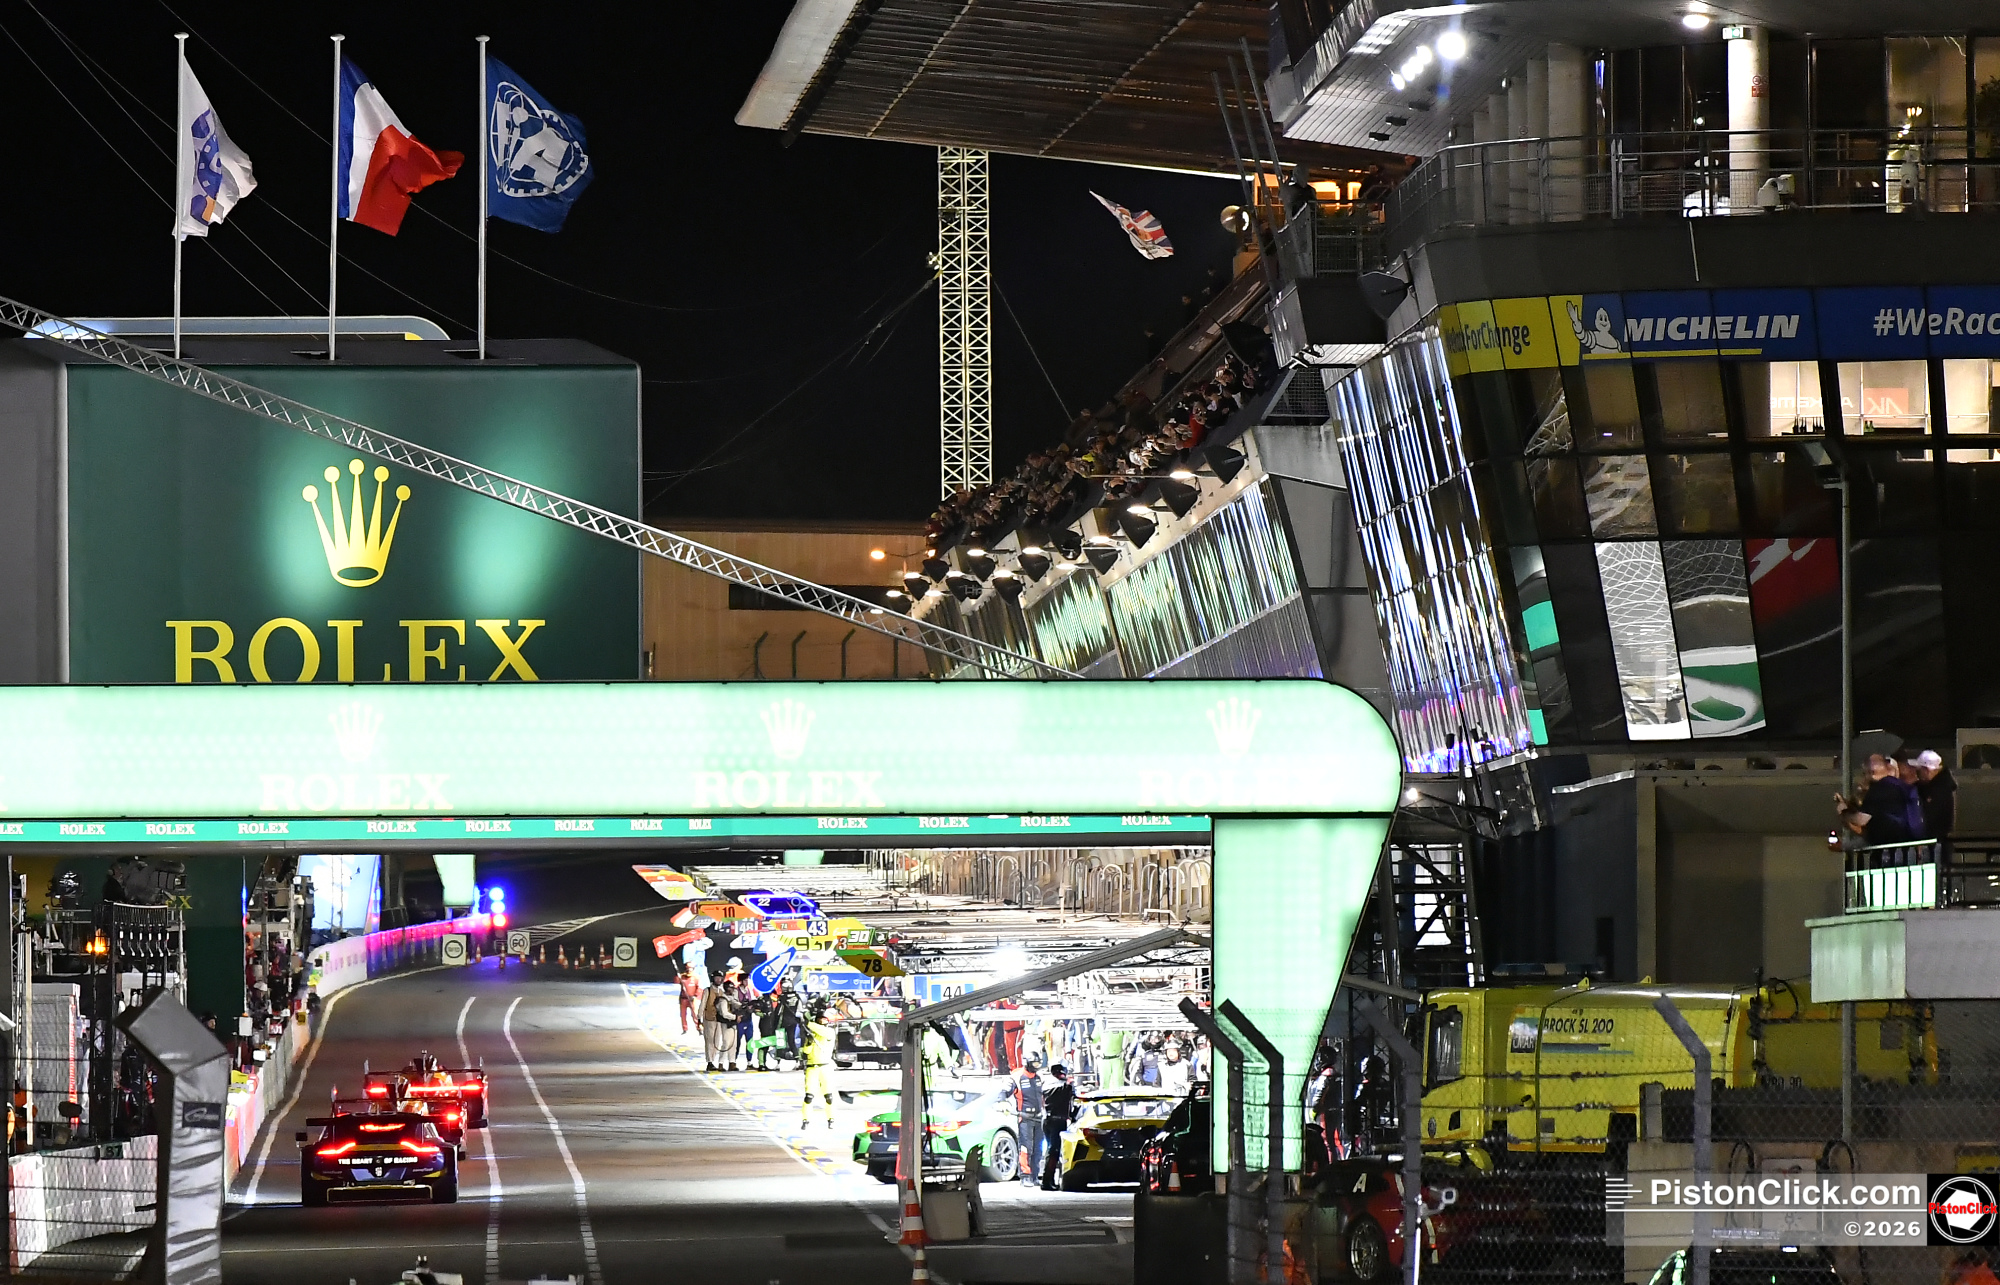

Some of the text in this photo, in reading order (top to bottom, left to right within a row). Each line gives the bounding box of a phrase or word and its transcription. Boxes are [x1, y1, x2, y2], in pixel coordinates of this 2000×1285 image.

[1624, 314, 1799, 342] MICHELIN
[1873, 308, 2000, 337] #WeRac
[166, 618, 546, 682] ROLEX
[259, 773, 454, 811] ROLEX
[692, 770, 886, 808] ROLEX
[59, 823, 106, 835] ROLEX
[145, 823, 196, 835] ROLEX
[237, 822, 290, 835] ROLEX
[366, 821, 417, 833] ROLEX
[465, 820, 512, 832] ROLEX
[554, 820, 595, 832] ROLEX
[630, 819, 663, 831] ROLEX
[688, 818, 712, 830] ROLEX
[817, 817, 868, 829] ROLEX
[918, 816, 970, 828] ROLEX
[1020, 815, 1071, 827] ROLEX
[1121, 815, 1172, 826] ROLEX
[757, 898, 770, 907] 22
[722, 906, 735, 918] 10
[808, 921, 828, 936] 43
[848, 930, 870, 943] 30
[862, 959, 883, 973] 78
[809, 975, 829, 990] 23
[943, 986, 962, 998] 44
[1578, 1018, 1589, 1034] SL
[1591, 1018, 1614, 1034] 200
[1352, 1172, 1368, 1193] A
